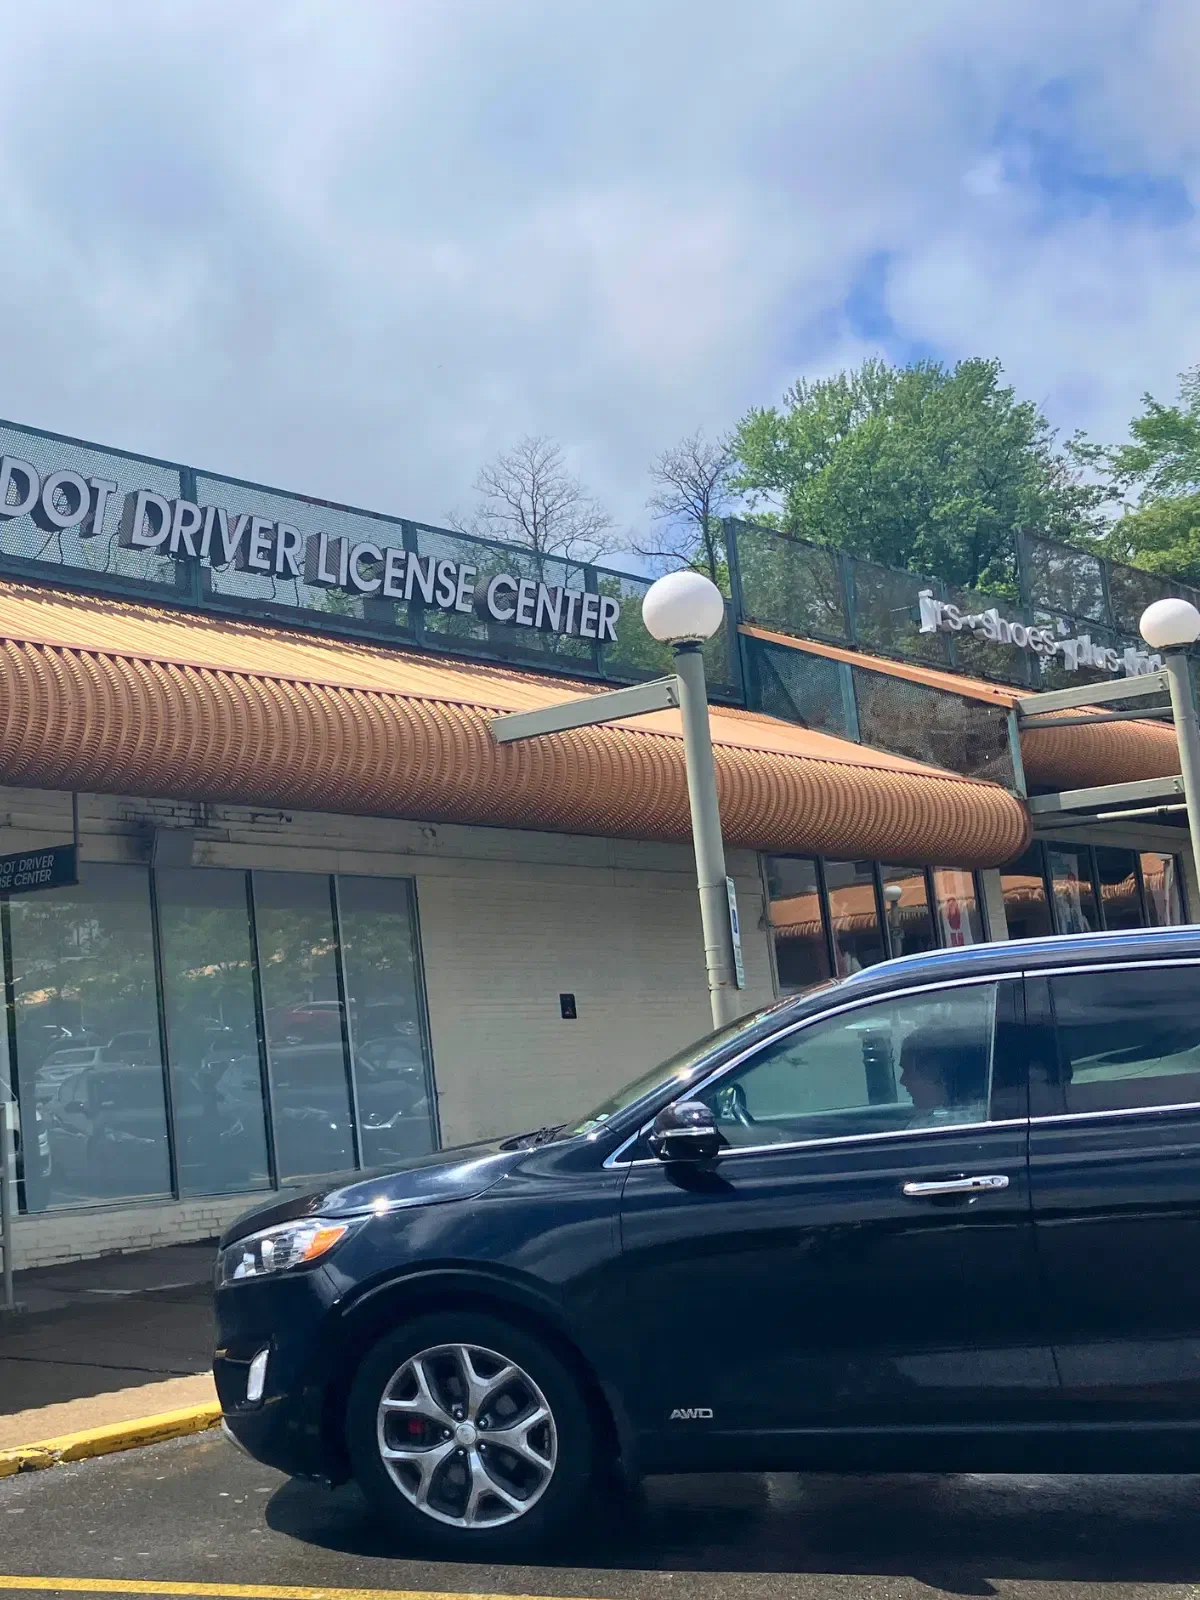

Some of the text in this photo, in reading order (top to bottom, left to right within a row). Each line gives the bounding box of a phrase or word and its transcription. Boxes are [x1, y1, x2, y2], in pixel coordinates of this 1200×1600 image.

[120, 488, 301, 577] DRIVER
[307, 531, 478, 614] LICENSE
[481, 572, 621, 642] CENTER
[975, 607, 1057, 655] shoes
[18, 854, 55, 873] DRIVER
[13, 868, 52, 887] CENTER
[669, 1407, 714, 1420] AWD
